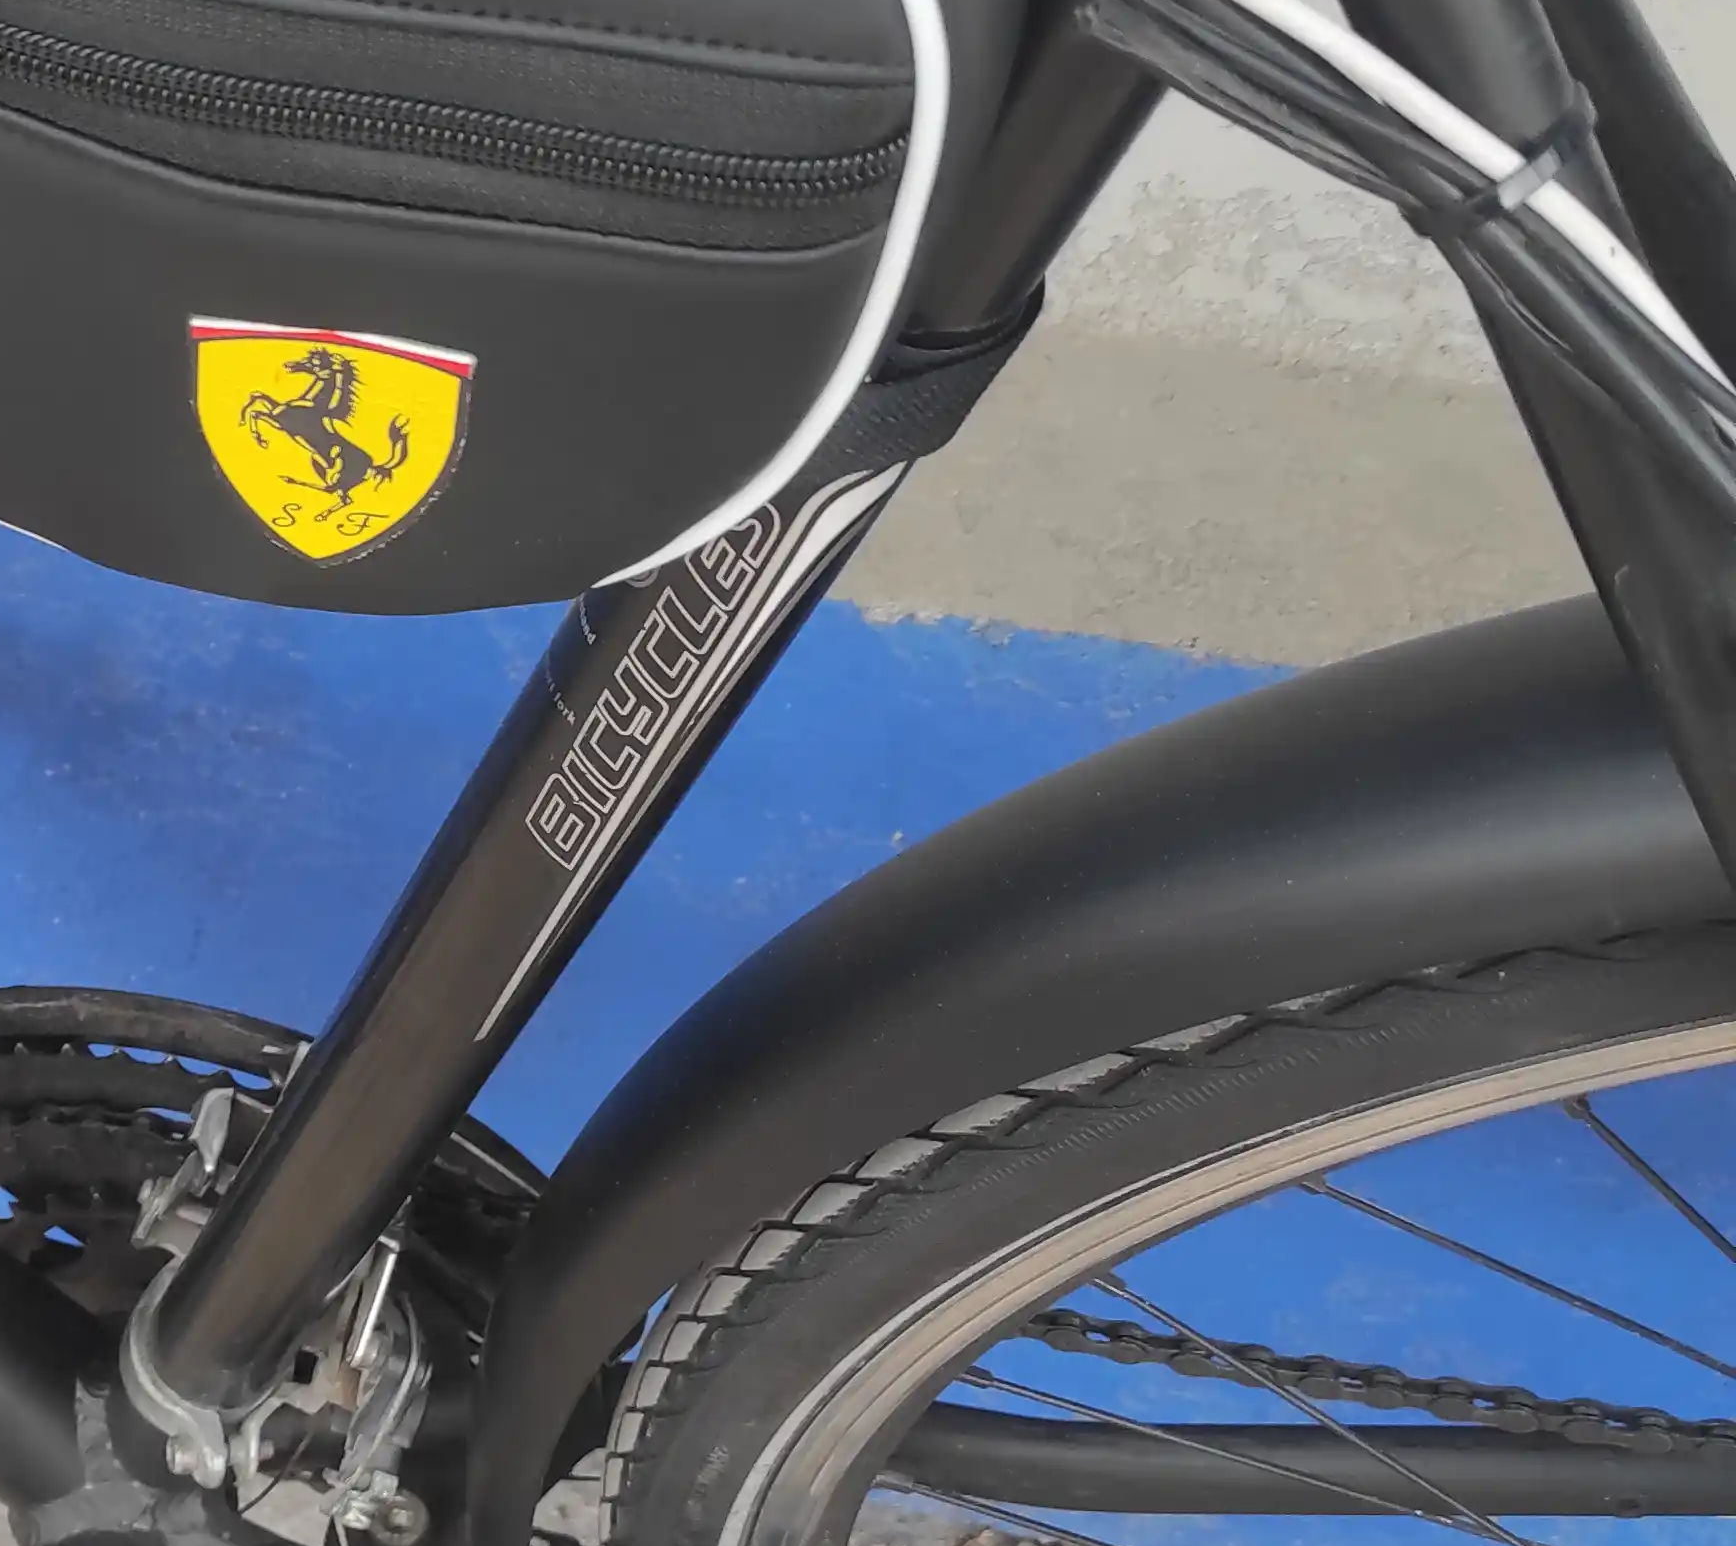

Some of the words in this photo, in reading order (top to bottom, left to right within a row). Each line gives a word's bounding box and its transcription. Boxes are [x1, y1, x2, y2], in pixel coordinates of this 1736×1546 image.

[271, 502, 303, 528] S
[335, 511, 391, 537] F
[524, 501, 782, 871] BICYCLES
